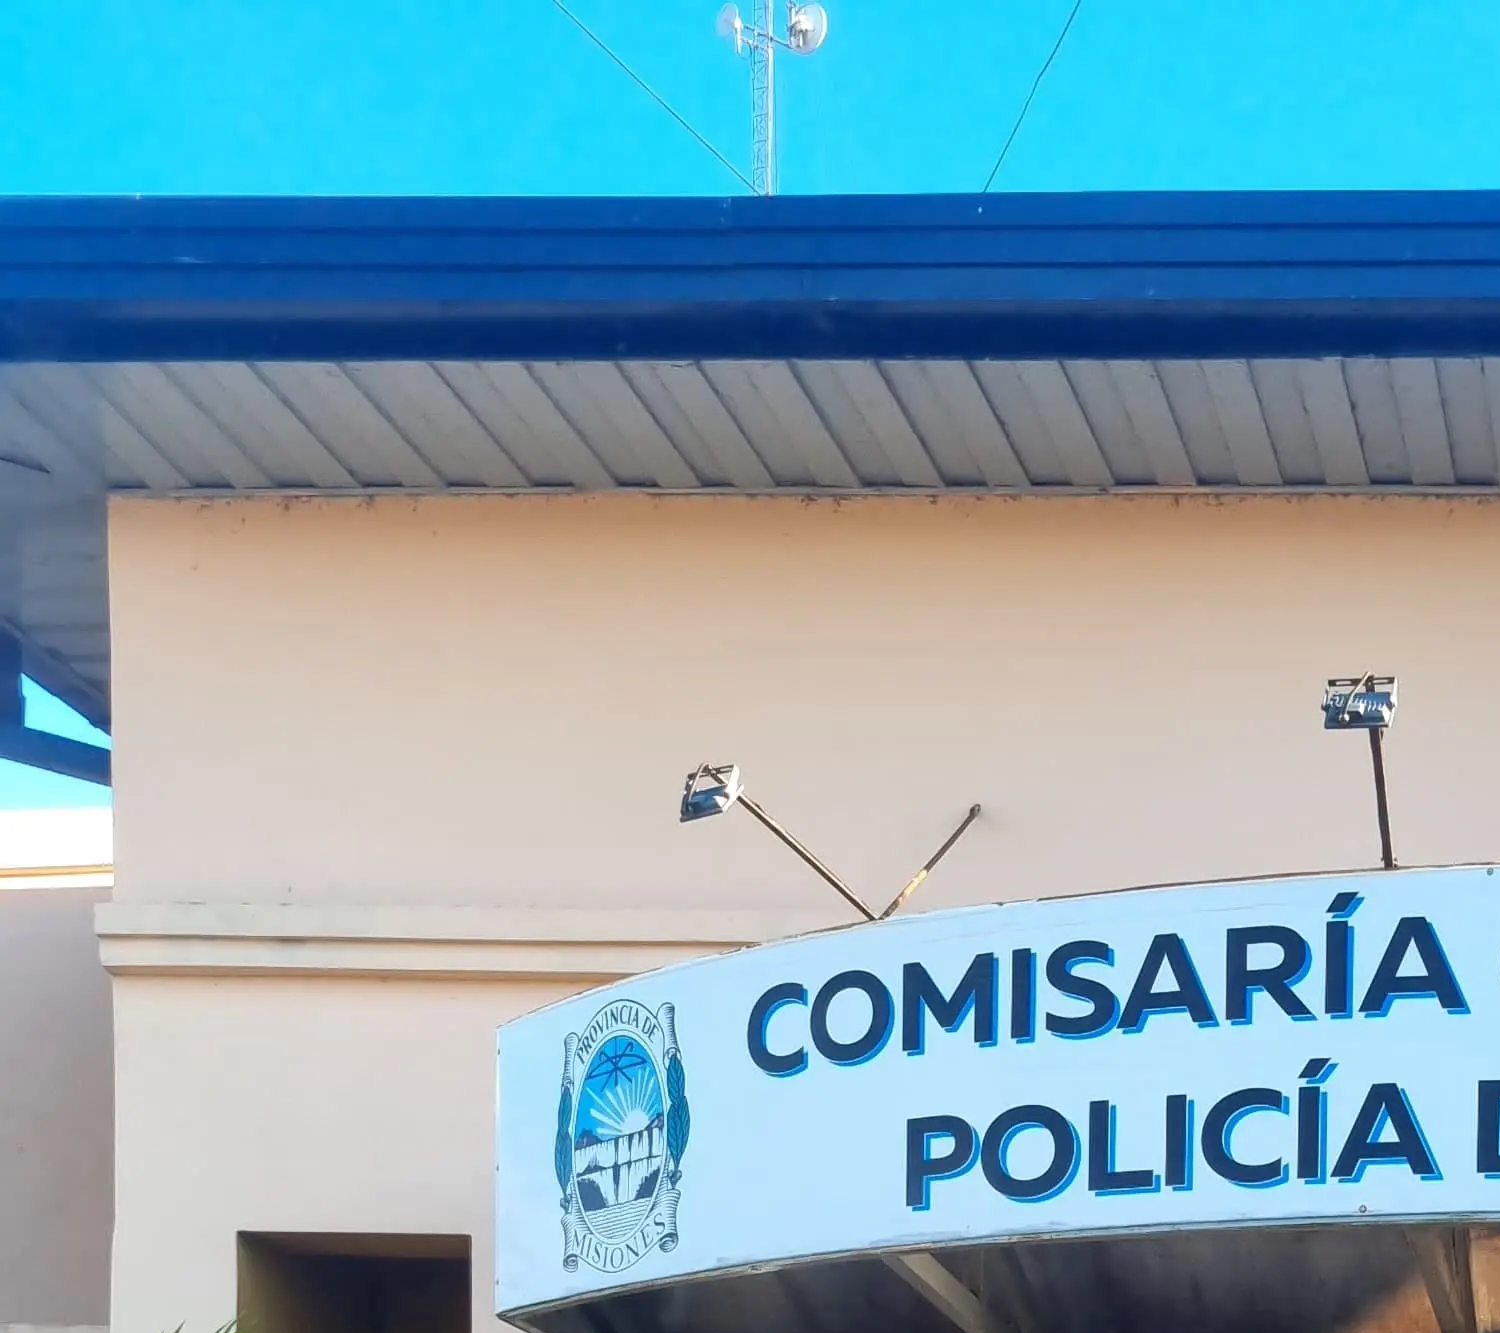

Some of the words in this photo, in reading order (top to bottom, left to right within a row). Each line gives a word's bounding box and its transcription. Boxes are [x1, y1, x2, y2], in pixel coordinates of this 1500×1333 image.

[576, 1004, 641, 1065] PROVINCIA
[642, 1016, 660, 1045] DE
[747, 892, 1470, 1078] COMISARÍA
[906, 1058, 1443, 1211] POLICÍA
[572, 1212, 667, 1269] MISIONES
